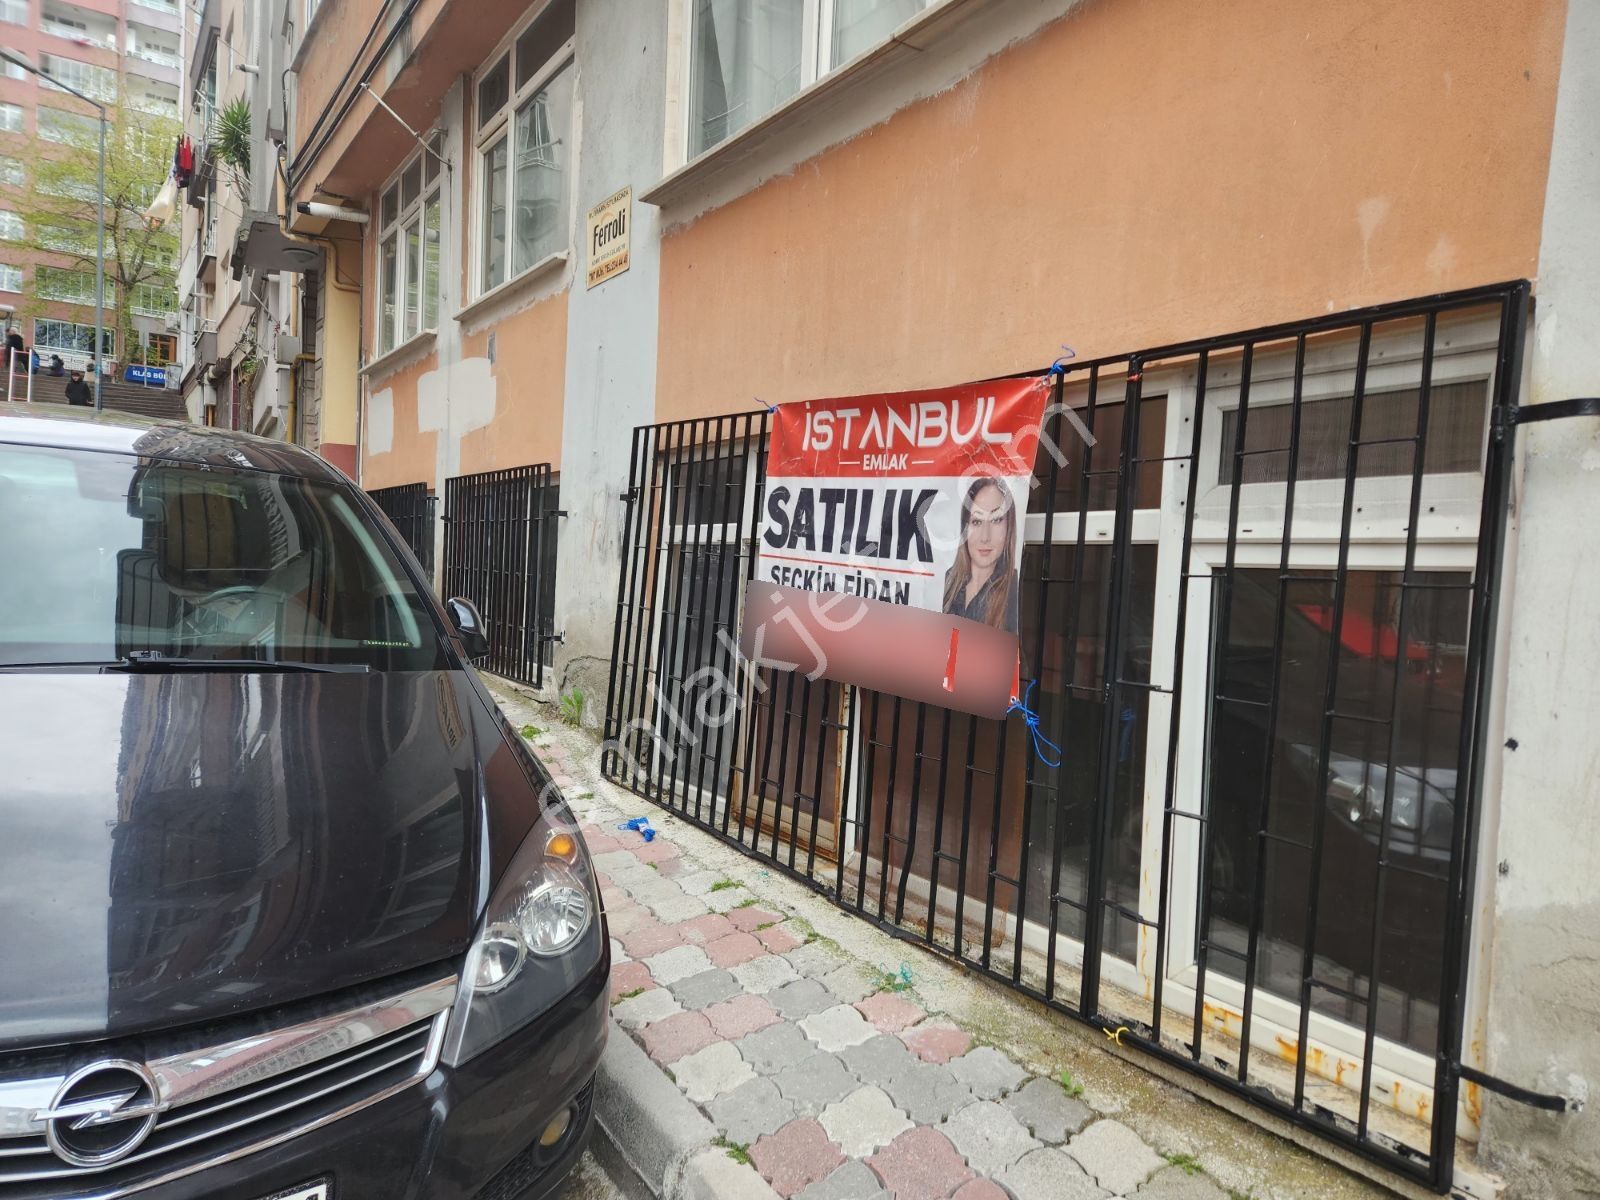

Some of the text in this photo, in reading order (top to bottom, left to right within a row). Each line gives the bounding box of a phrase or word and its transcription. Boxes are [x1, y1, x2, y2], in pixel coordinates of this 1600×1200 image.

[593, 208, 626, 256] Ferroli
[153, 372, 167, 380] BÜ
[802, 396, 1013, 452] İSTANBUL
[862, 453, 908, 471] EMLAK
[763, 486, 939, 563] SATILIK
